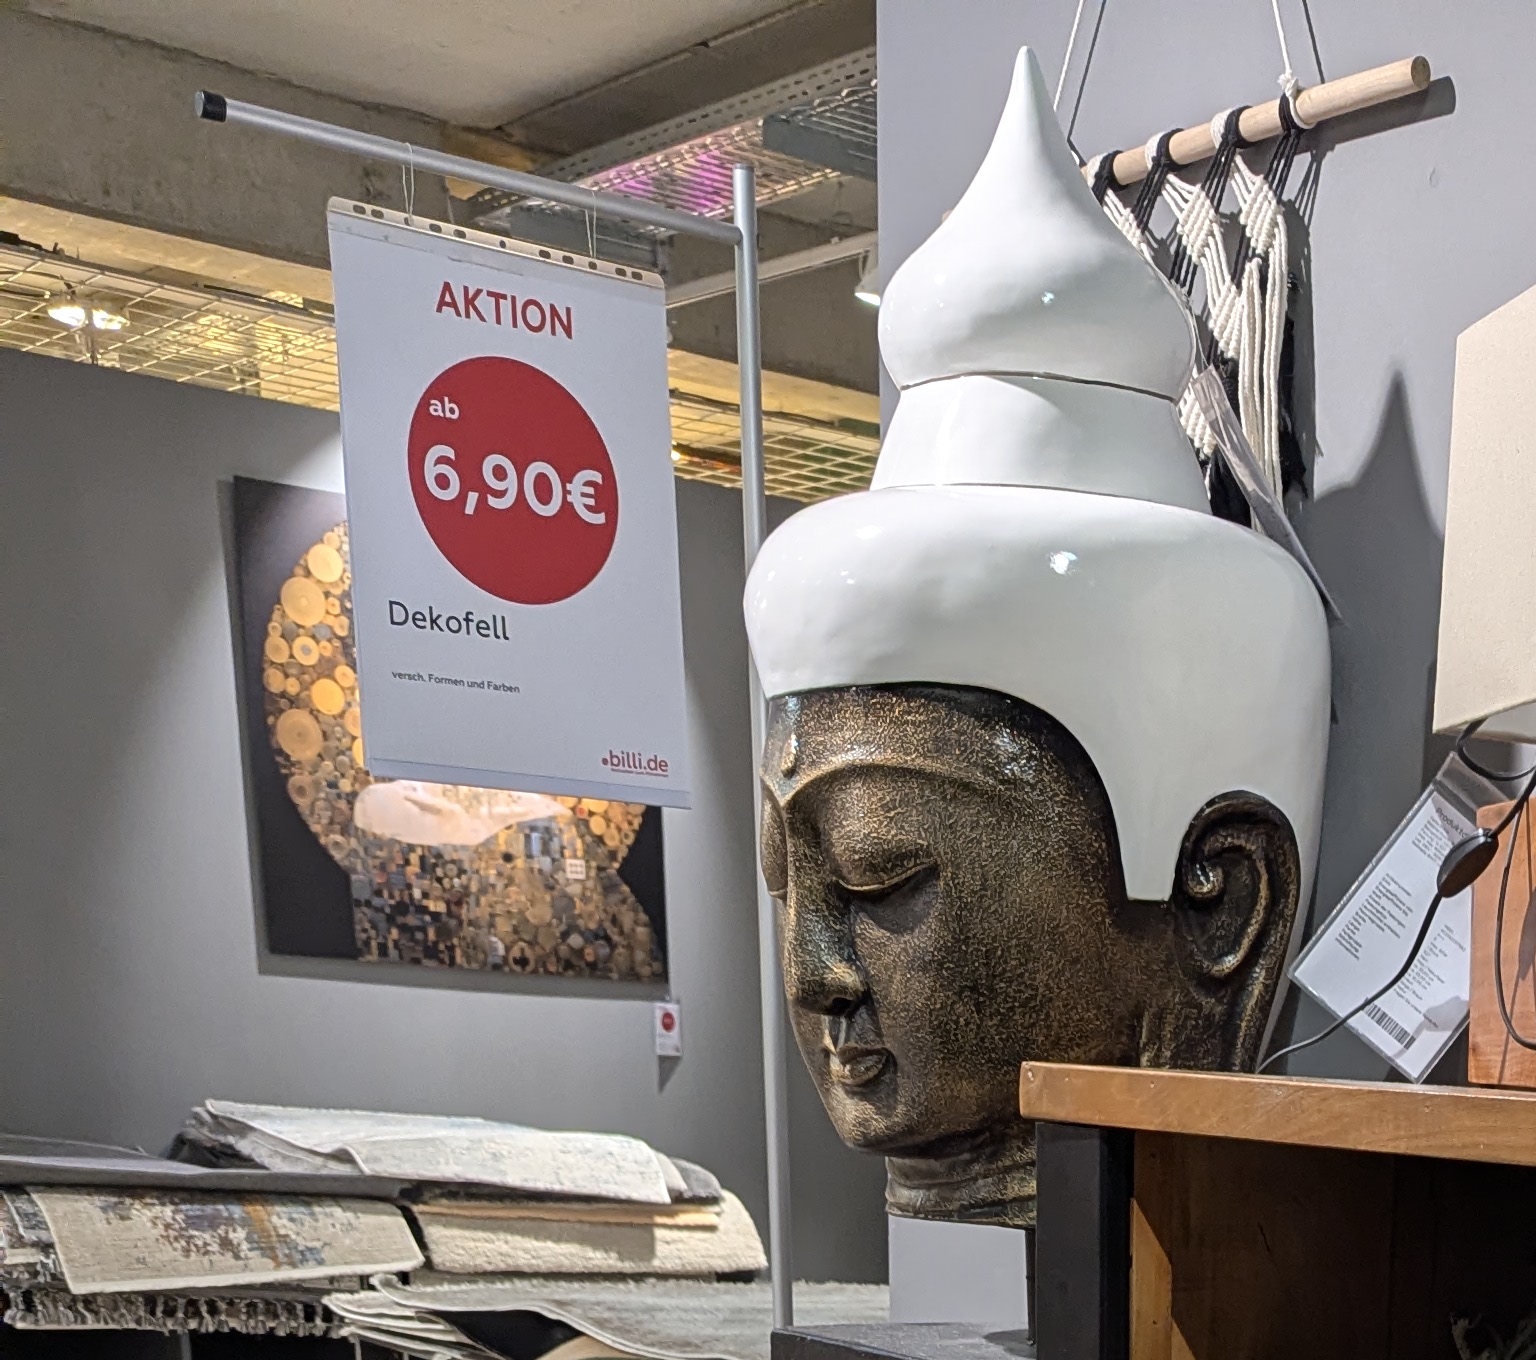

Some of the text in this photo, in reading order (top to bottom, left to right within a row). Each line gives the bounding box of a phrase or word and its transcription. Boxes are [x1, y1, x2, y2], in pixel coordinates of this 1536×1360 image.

[436, 281, 573, 340] AKTION
[429, 397, 460, 420] ab
[424, 444, 607, 525] 6,90€
[388, 600, 510, 641] Dekofell
[428, 673, 465, 688] Formen
[466, 680, 485, 690] und
[487, 680, 520, 694] Farben
